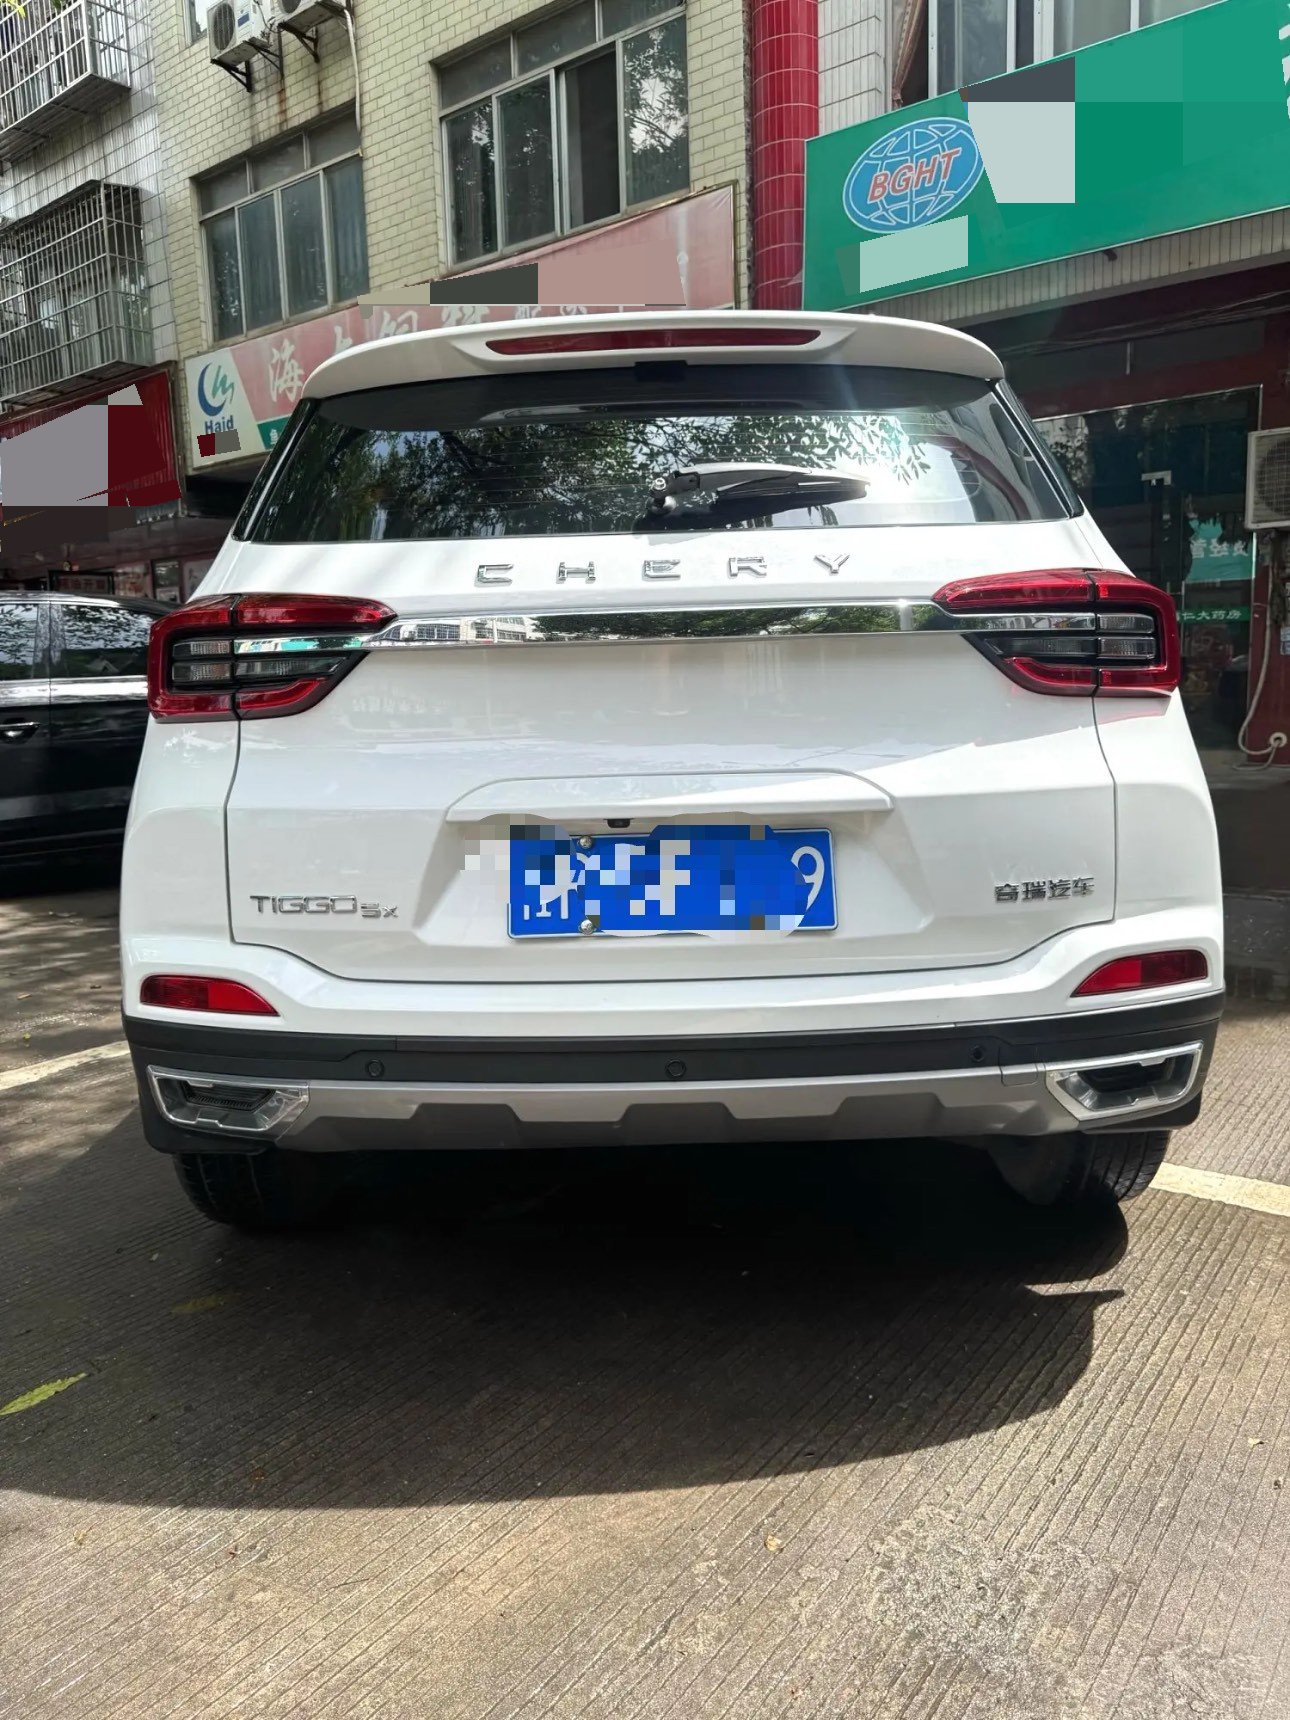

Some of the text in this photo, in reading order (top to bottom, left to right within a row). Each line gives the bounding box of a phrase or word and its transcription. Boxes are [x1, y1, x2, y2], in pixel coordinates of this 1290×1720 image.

[868, 148, 962, 203] BGHT
[205, 415, 234, 434] Haid
[475, 553, 851, 585] CHERY
[995, 877, 1094, 902] 奇瑞汽车
[250, 895, 357, 914] TIGGO
